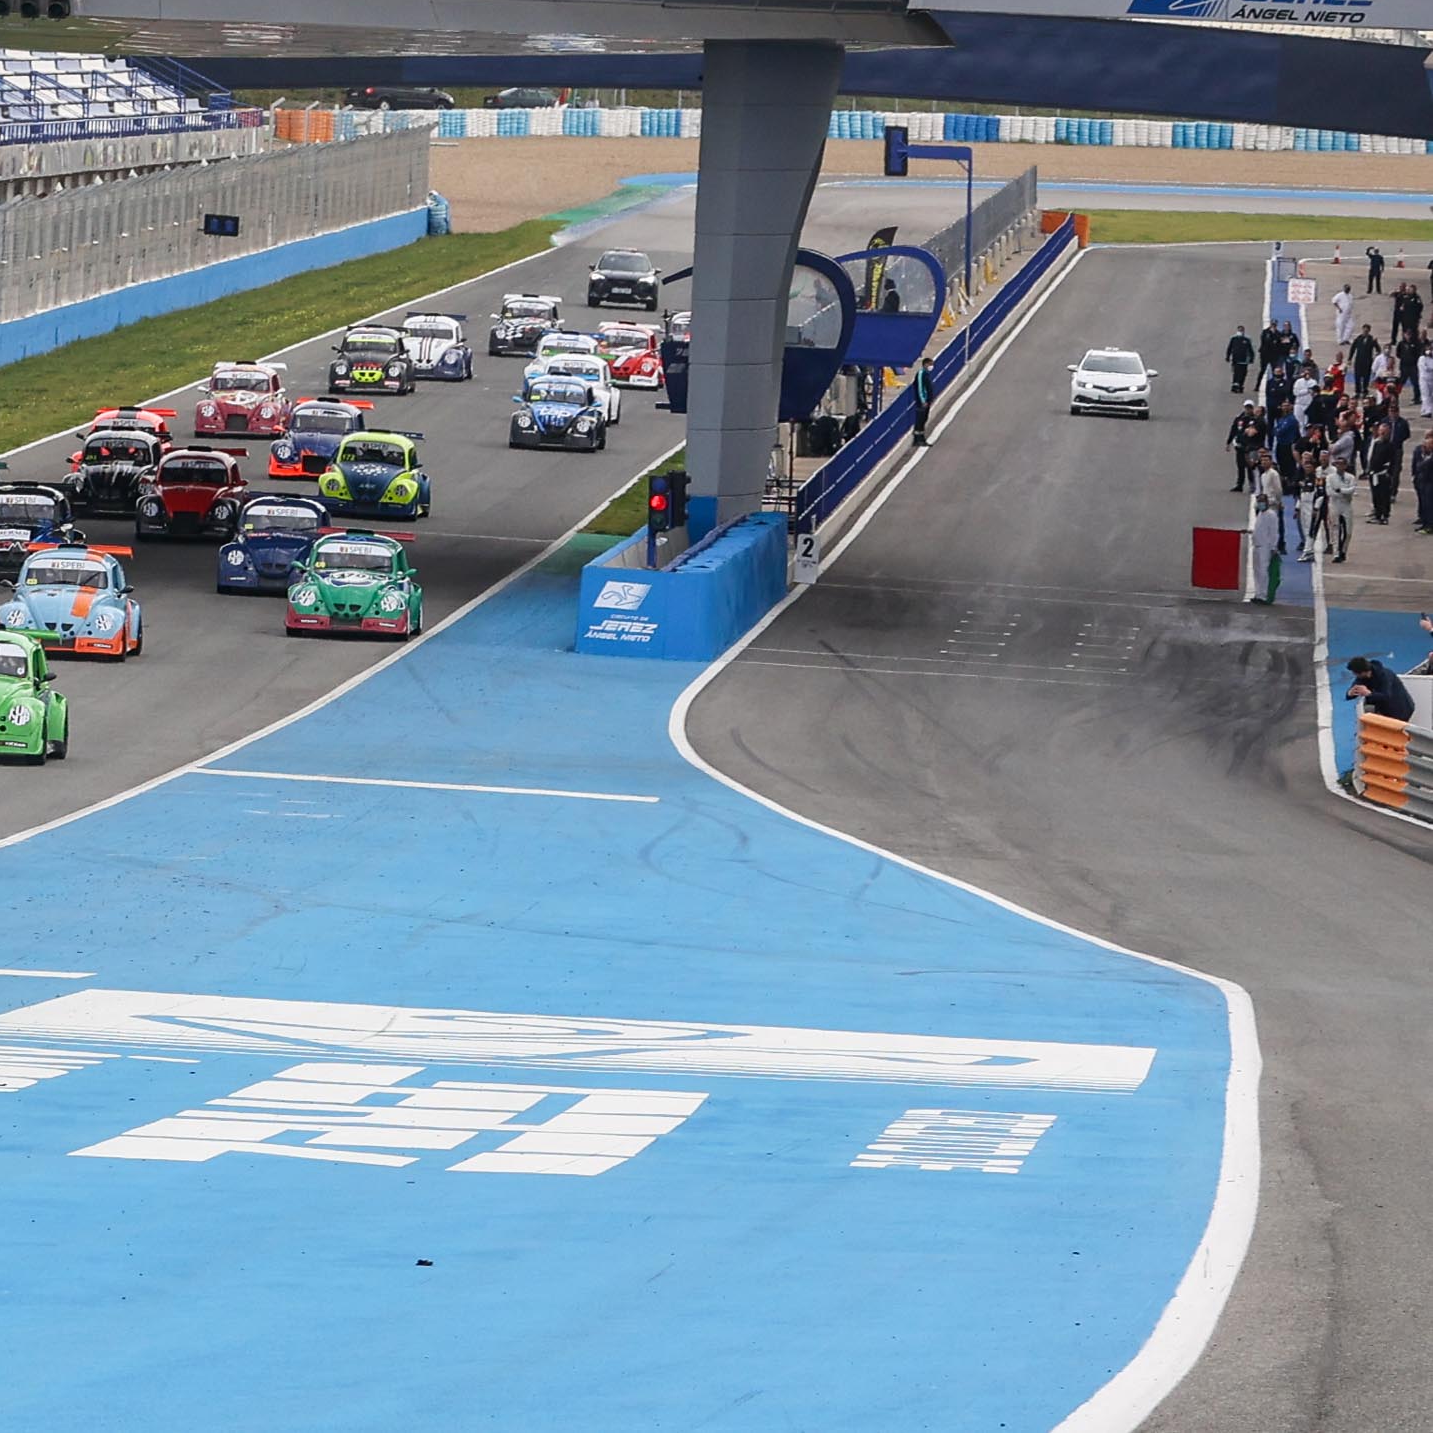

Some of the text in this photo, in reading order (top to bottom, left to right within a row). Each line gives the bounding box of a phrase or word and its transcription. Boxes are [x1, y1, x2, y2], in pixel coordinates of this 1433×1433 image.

[1232, 4, 1366, 23] ÁNGEL NIETO
[802, 537, 814, 558] 2
[589, 619, 658, 634] JEREZ
